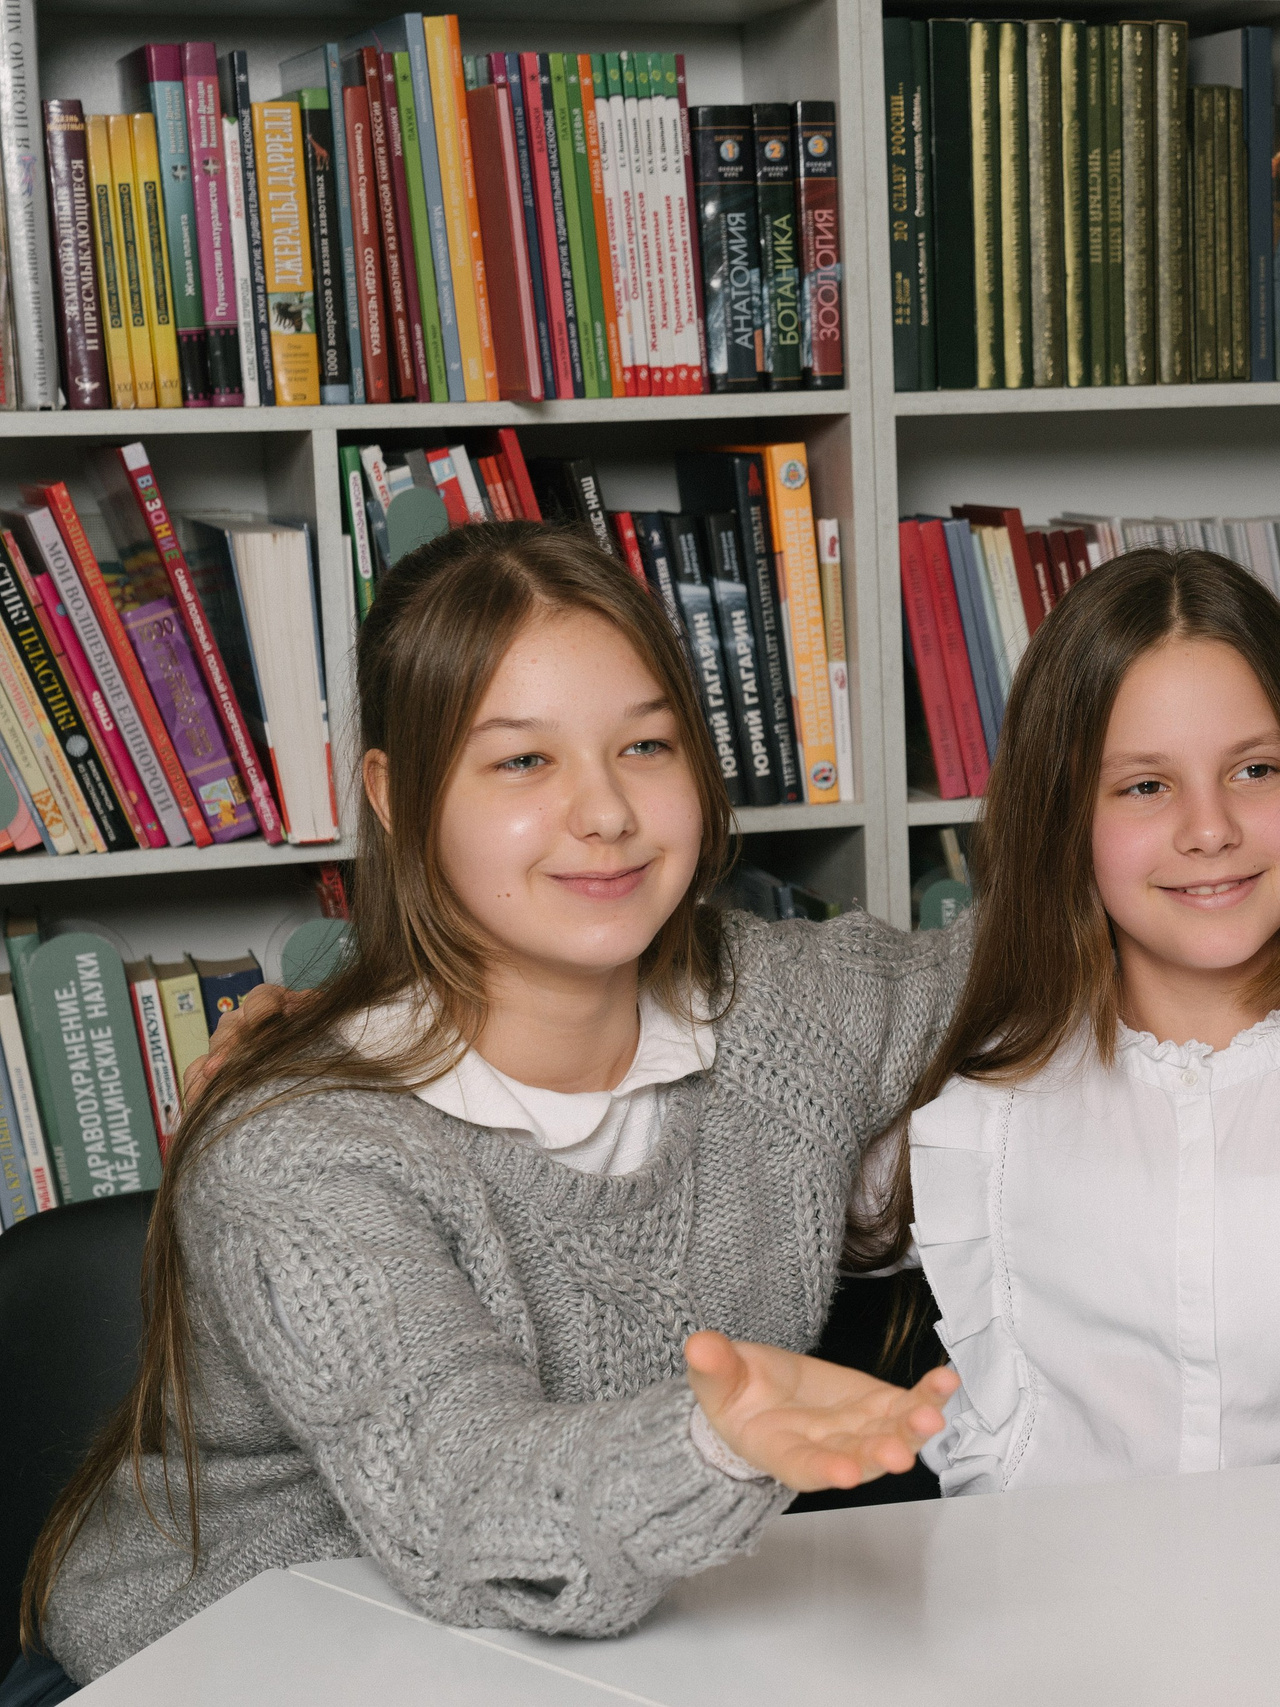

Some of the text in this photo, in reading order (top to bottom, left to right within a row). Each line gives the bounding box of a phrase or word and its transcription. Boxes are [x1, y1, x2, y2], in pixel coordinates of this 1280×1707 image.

[8, 42, 28, 128] ПОЗНАЮ
[404, 107, 416, 141] ПАУКИ
[15, 138, 30, 150] Я
[240, 107, 255, 168] НАСЕКОМЫЕ
[513, 105, 534, 207] ДЕЛЬФИНЫ И КИТЫ
[531, 106, 546, 152] БАБОЧКИ
[572, 106, 586, 154] ДЕРЕВЬЯ
[587, 109, 598, 146] ЯГОДЫ
[726, 143, 735, 158] 1
[768, 143, 781, 158] 2
[813, 139, 824, 153] 3
[246, 170, 262, 245] УДИВИТЕЛЬНЫЕ
[264, 107, 303, 286] ДЖЕРАЛЬД ДАРРЕЛЛ
[372, 100, 404, 312] ЖИВОТНЫЕ ИЗ КРАСНОЙ КНИГИ РОССИИ
[591, 159, 603, 193] ГРИБЫ
[892, 162, 907, 211] СЛАВУ
[72, 159, 98, 350] И ПРЕСМЫКАЮЩИЕСЯ
[207, 180, 229, 316] Путешествия натуралистов
[606, 197, 616, 241] океаны
[622, 190, 639, 300] Опасная природа
[893, 220, 907, 241] ВО
[182, 259, 194, 296] Живая
[253, 247, 264, 284] ДРУГИЕ
[316, 174, 337, 376] 1000 вопросов о жизни животных
[610, 254, 621, 283] моря
[638, 192, 658, 350] Животные наших лесов
[652, 210, 669, 329] Хищные животные
[666, 196, 683, 334] Тропические растения
[678, 196, 694, 322] Экзотические птицы
[726, 212, 754, 350] АНАТОМИЯ
[772, 212, 799, 345] БОТАНИКА
[812, 208, 841, 341] ЗООЛОГИЯ
[256, 293, 267, 323] ЖУКИ
[362, 246, 382, 355] СОСЕДИ ЧЕЛОВЕКА
[371, 460, 383, 482] ЧТО
[579, 475, 600, 510] НАШ
[134, 476, 179, 559] ВЯЗАНИЕ
[172, 566, 194, 602] САМЫЙ
[749, 505, 797, 787] ПЕРВЫЙ КОСМОНАВТ ПЛАНЕТЫ ЗЕМЛЯ
[784, 508, 819, 746] БОЛЬШАЯ ЭНЦИКЛОПЕДИЯ
[14, 628, 84, 729] ПЛАСТИК!
[44, 542, 72, 584] МОИ
[65, 586, 122, 698] ВОЛШЕБНЫЕ
[115, 706, 172, 811] ЕДИНОРОГИ
[89, 689, 115, 732] СТИЛЬ
[203, 653, 227, 694] ПОЛНЫЙ
[219, 693, 229, 701] И
[692, 610, 739, 780] ЮРИЙ ГАГАРИН
[730, 608, 771, 778] ЮРИЙ ГАГАРИН
[810, 624, 832, 745] ВОЛШЕБНЫХ
[221, 699, 254, 768] СОВРЕМЕННЫЙ
[140, 993, 166, 1064] ДИКУЛЯ
[55, 980, 118, 1196] ЗДРАВООХРАНЕНИЕ.
[74, 950, 146, 1190] МЕДИЦИНСКИЕ НАУКИ
